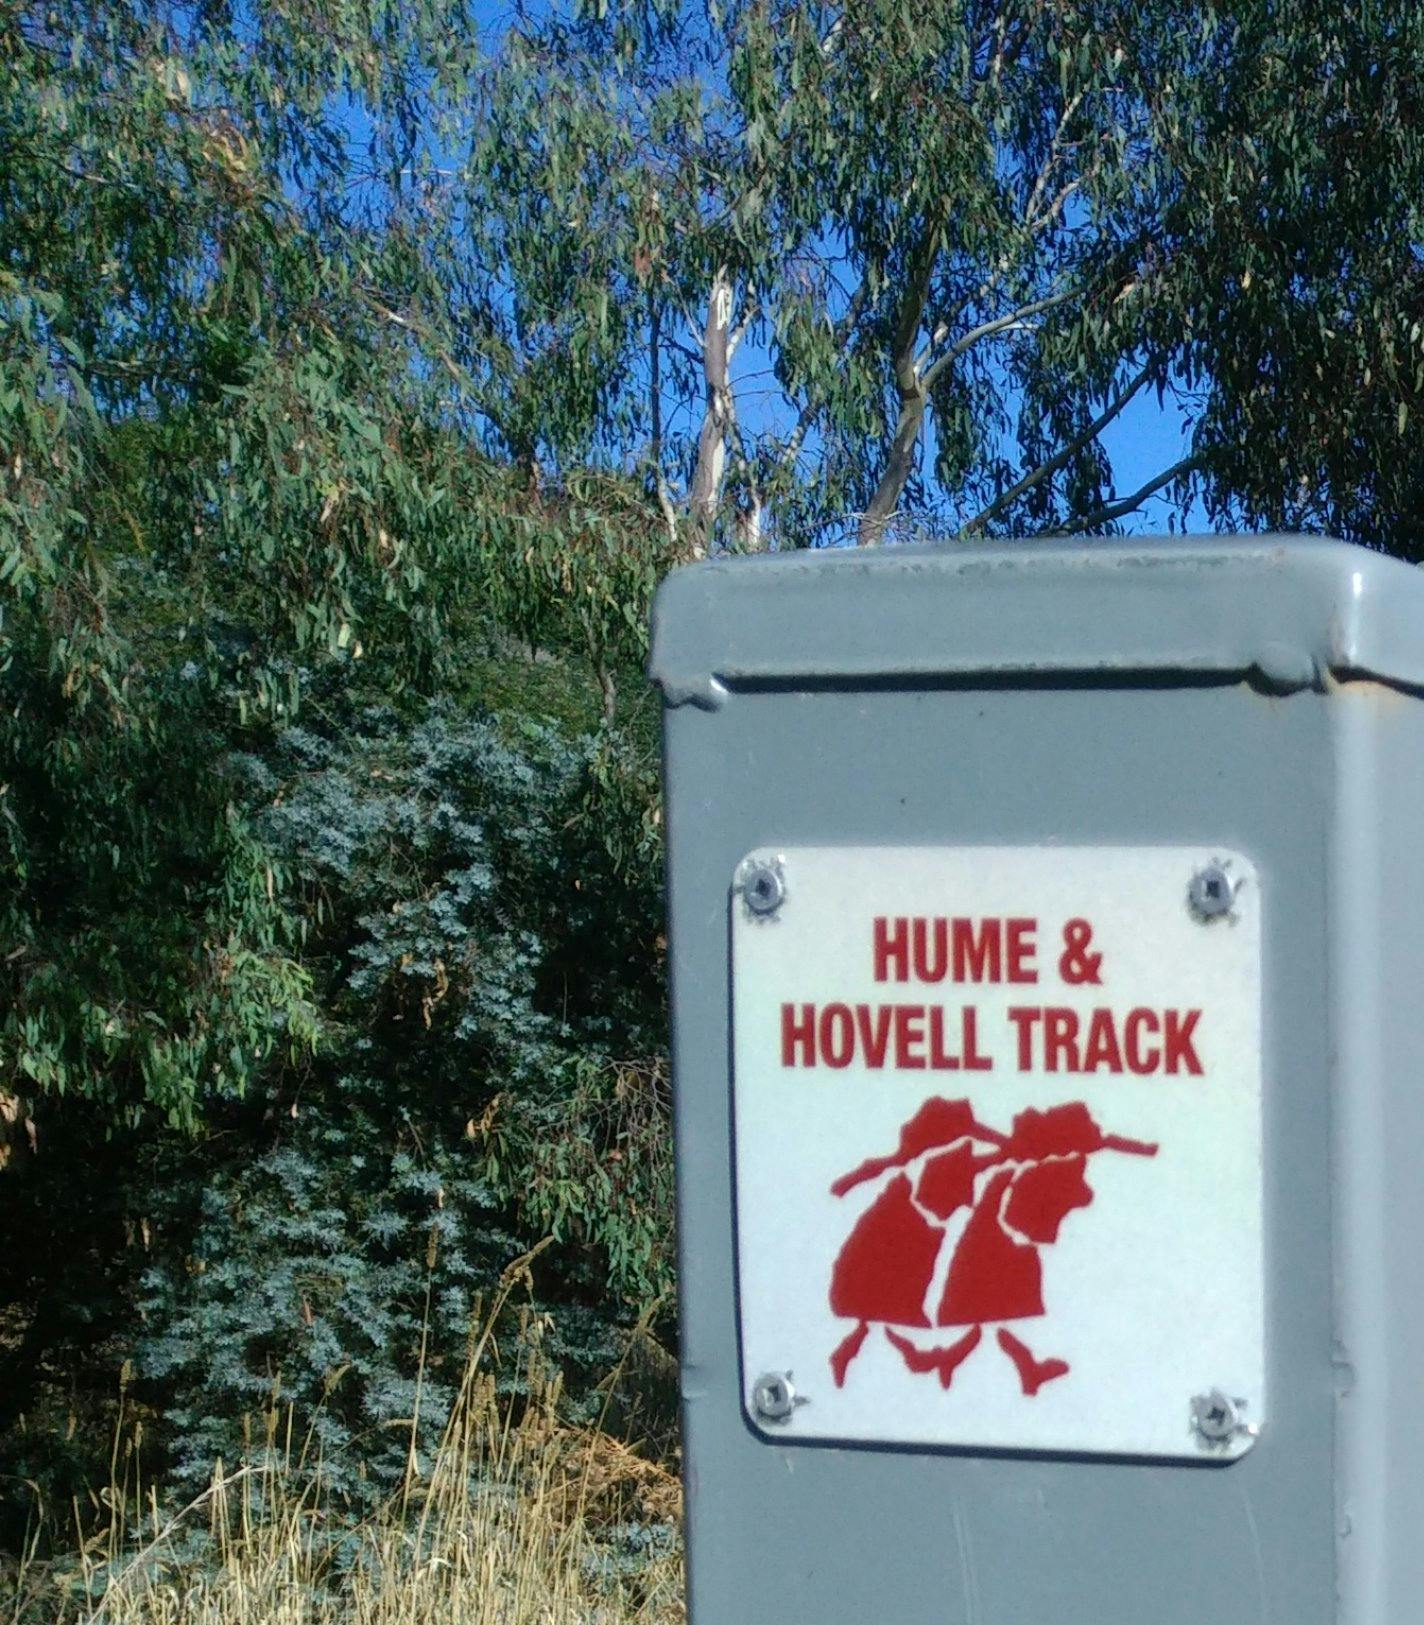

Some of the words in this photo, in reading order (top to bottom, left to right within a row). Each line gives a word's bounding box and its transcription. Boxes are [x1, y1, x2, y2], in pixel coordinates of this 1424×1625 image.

[873, 917, 1038, 984] HUME
[1059, 918, 1103, 985] &
[782, 1003, 993, 1071] HOVELL
[1008, 1007, 1204, 1075] TRACK
